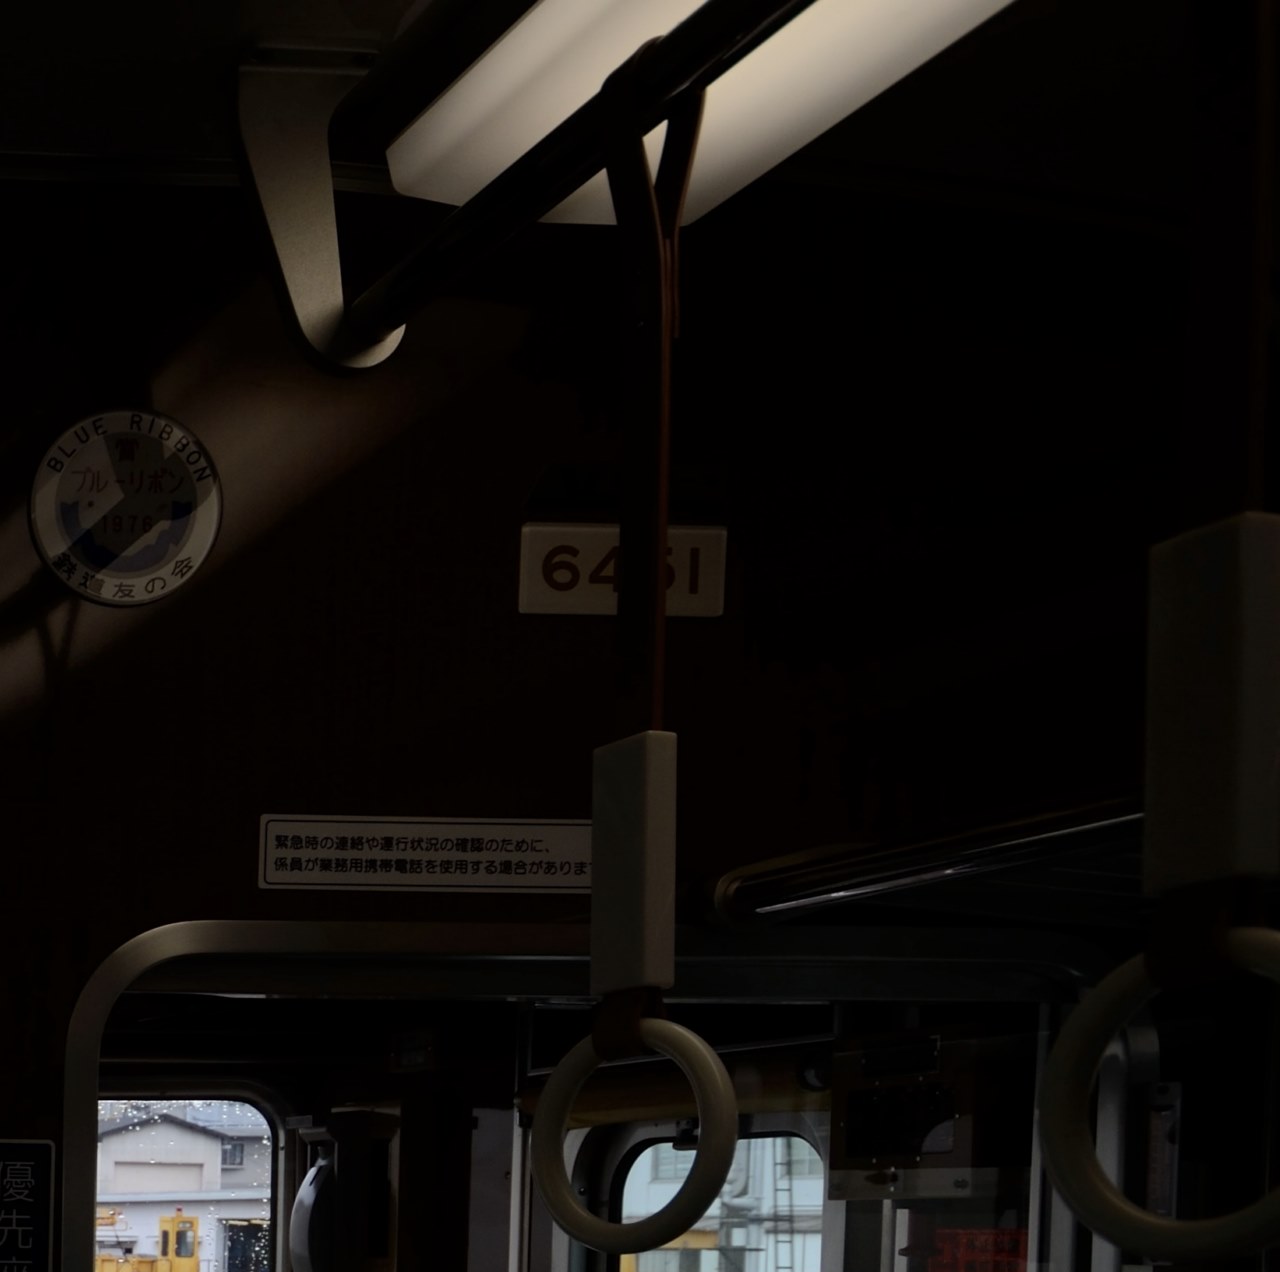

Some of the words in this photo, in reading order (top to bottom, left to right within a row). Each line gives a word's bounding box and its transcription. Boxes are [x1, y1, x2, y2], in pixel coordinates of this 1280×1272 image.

[47, 417, 108, 473] BLUE
[129, 414, 212, 482] RIBBON
[71, 467, 185, 495] ブルーリボン
[102, 515, 154, 534] 1976
[52, 553, 194, 598] 鉄道友の会
[274, 856, 592, 876] 係員が業務用携帯電話を使用する場合がありま
